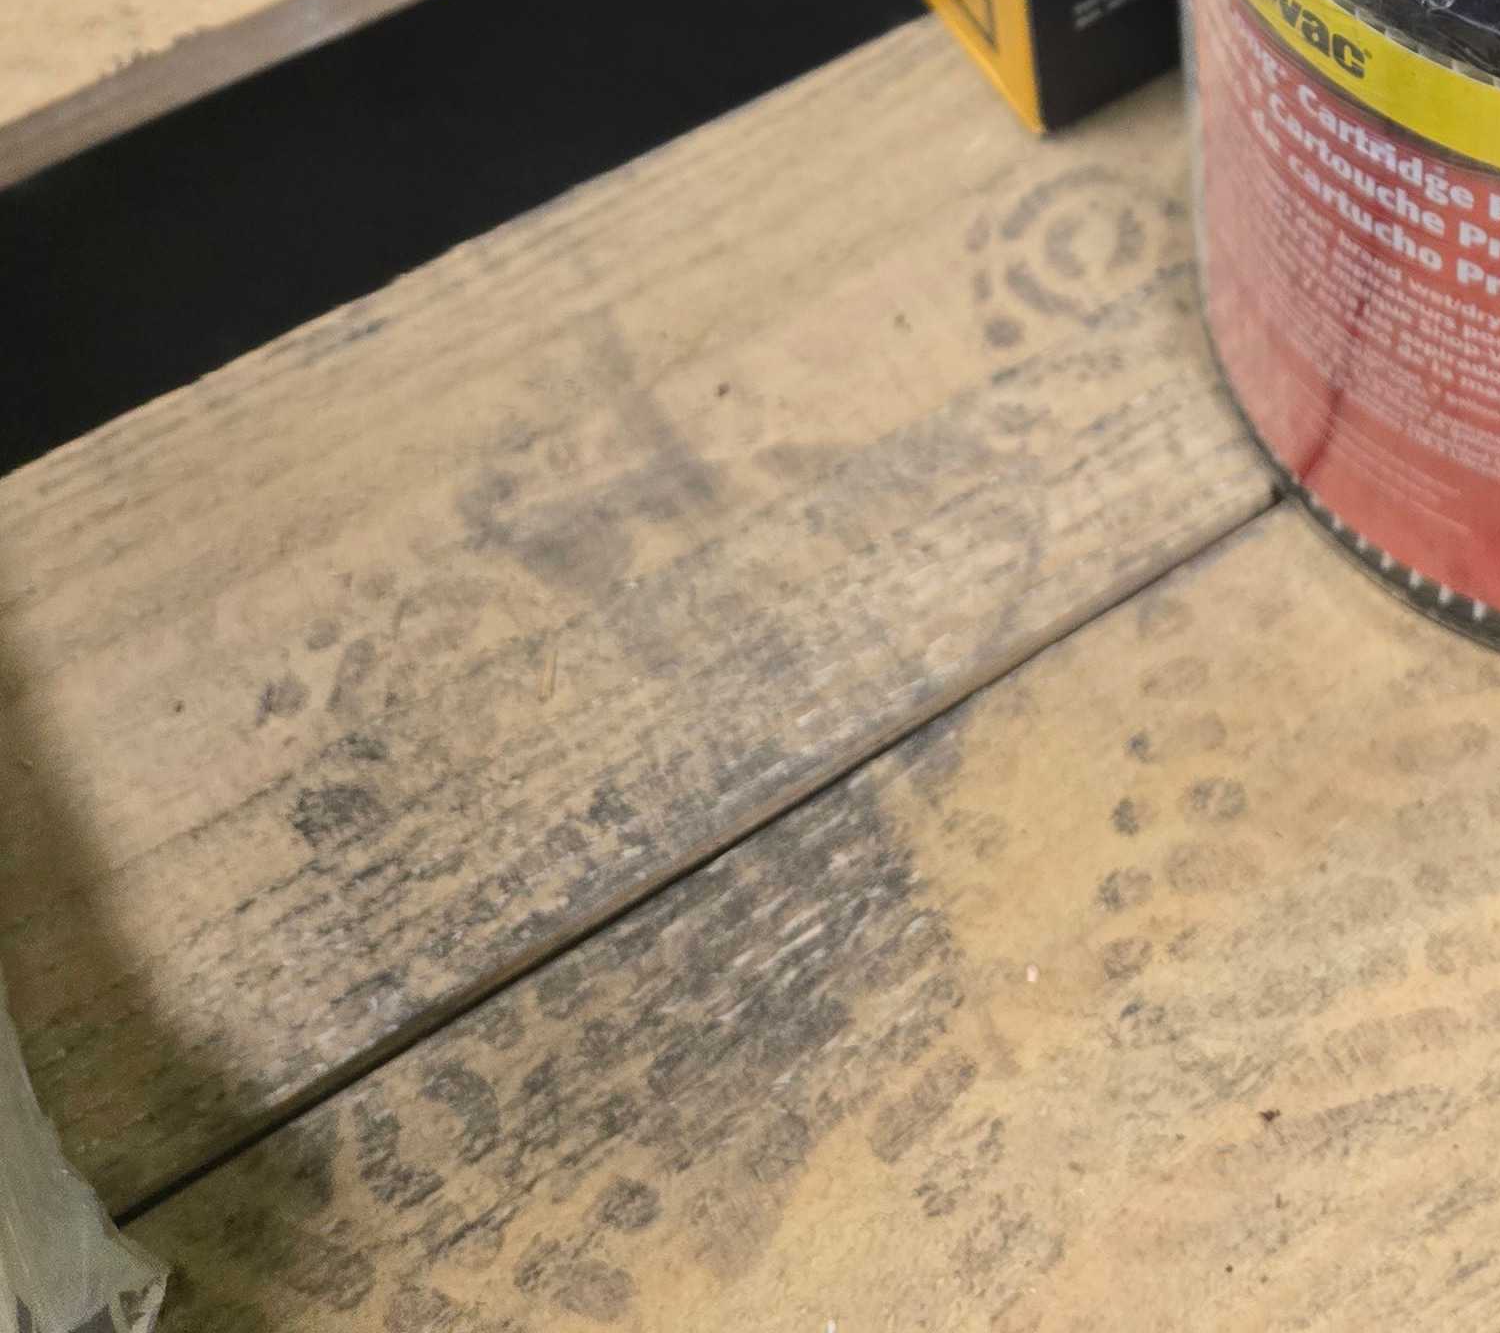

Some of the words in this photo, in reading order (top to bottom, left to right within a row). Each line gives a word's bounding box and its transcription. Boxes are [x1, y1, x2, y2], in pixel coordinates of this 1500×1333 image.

[1268, 93, 1446, 238] Cartouche
[1299, 84, 1474, 212] Cartridge
[1287, 153, 1443, 273] cartucho
